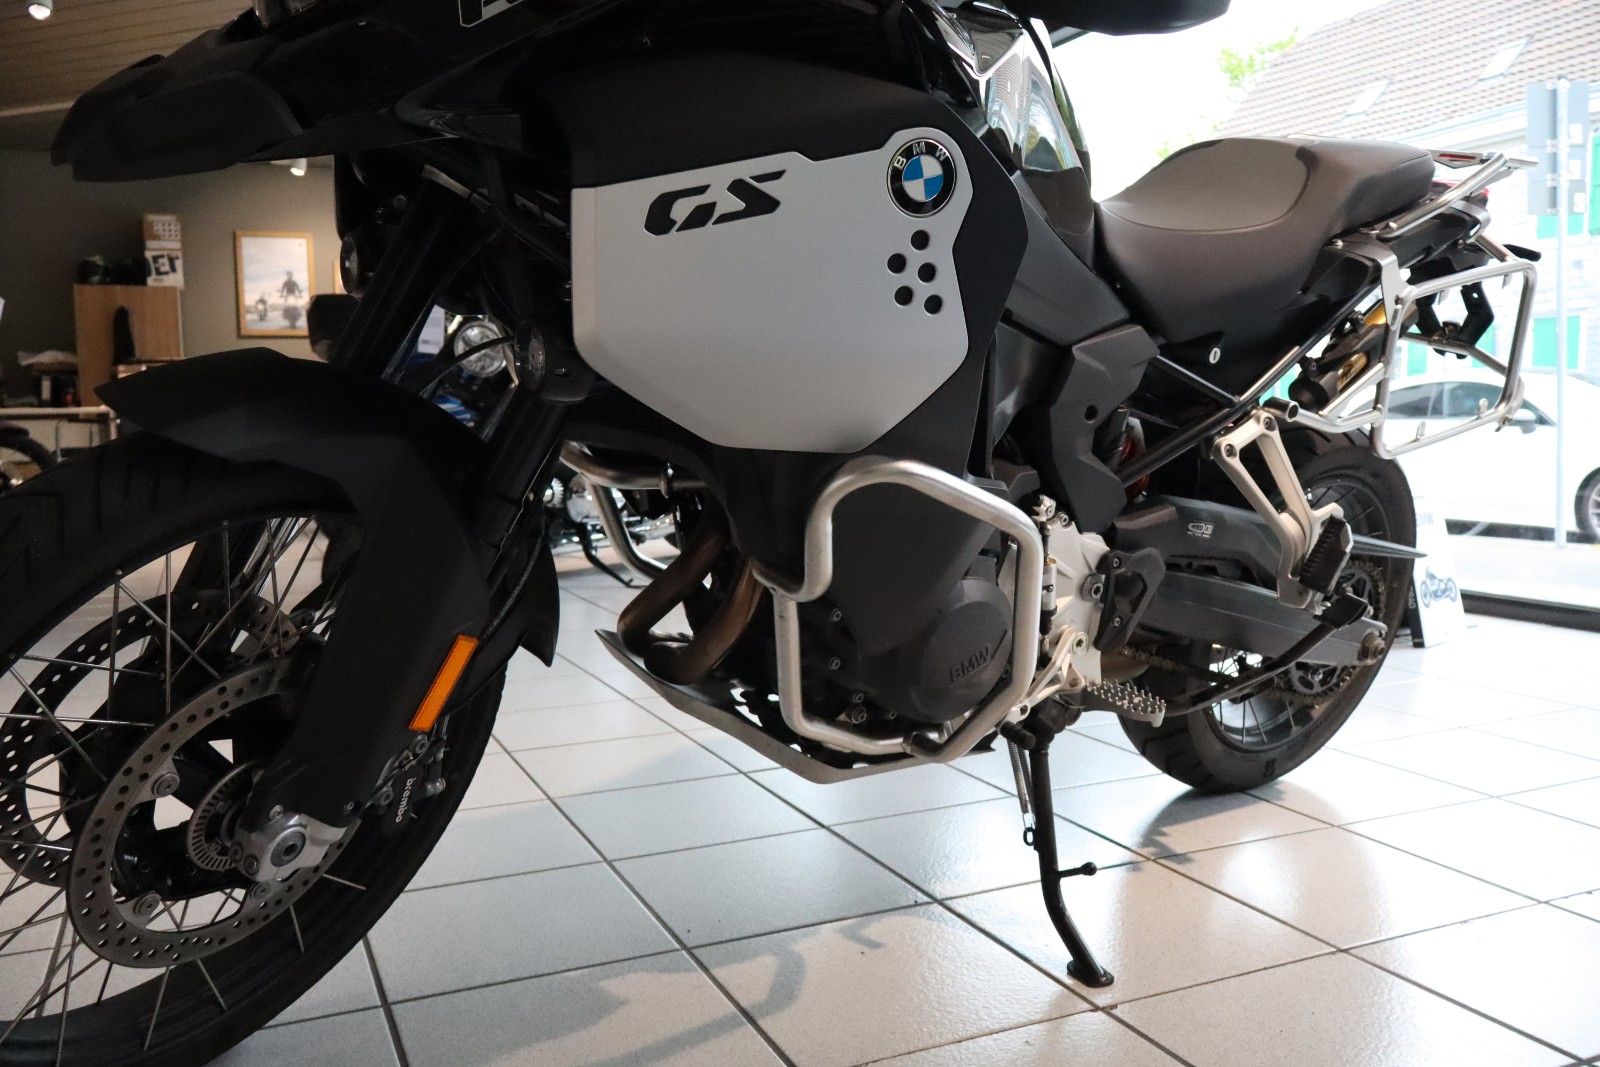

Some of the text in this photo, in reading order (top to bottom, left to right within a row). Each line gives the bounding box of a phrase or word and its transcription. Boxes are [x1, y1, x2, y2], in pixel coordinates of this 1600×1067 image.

[893, 141, 948, 170] BMW
[643, 169, 787, 236] GS
[949, 646, 989, 683] BMW
[395, 777, 417, 823] brembo
